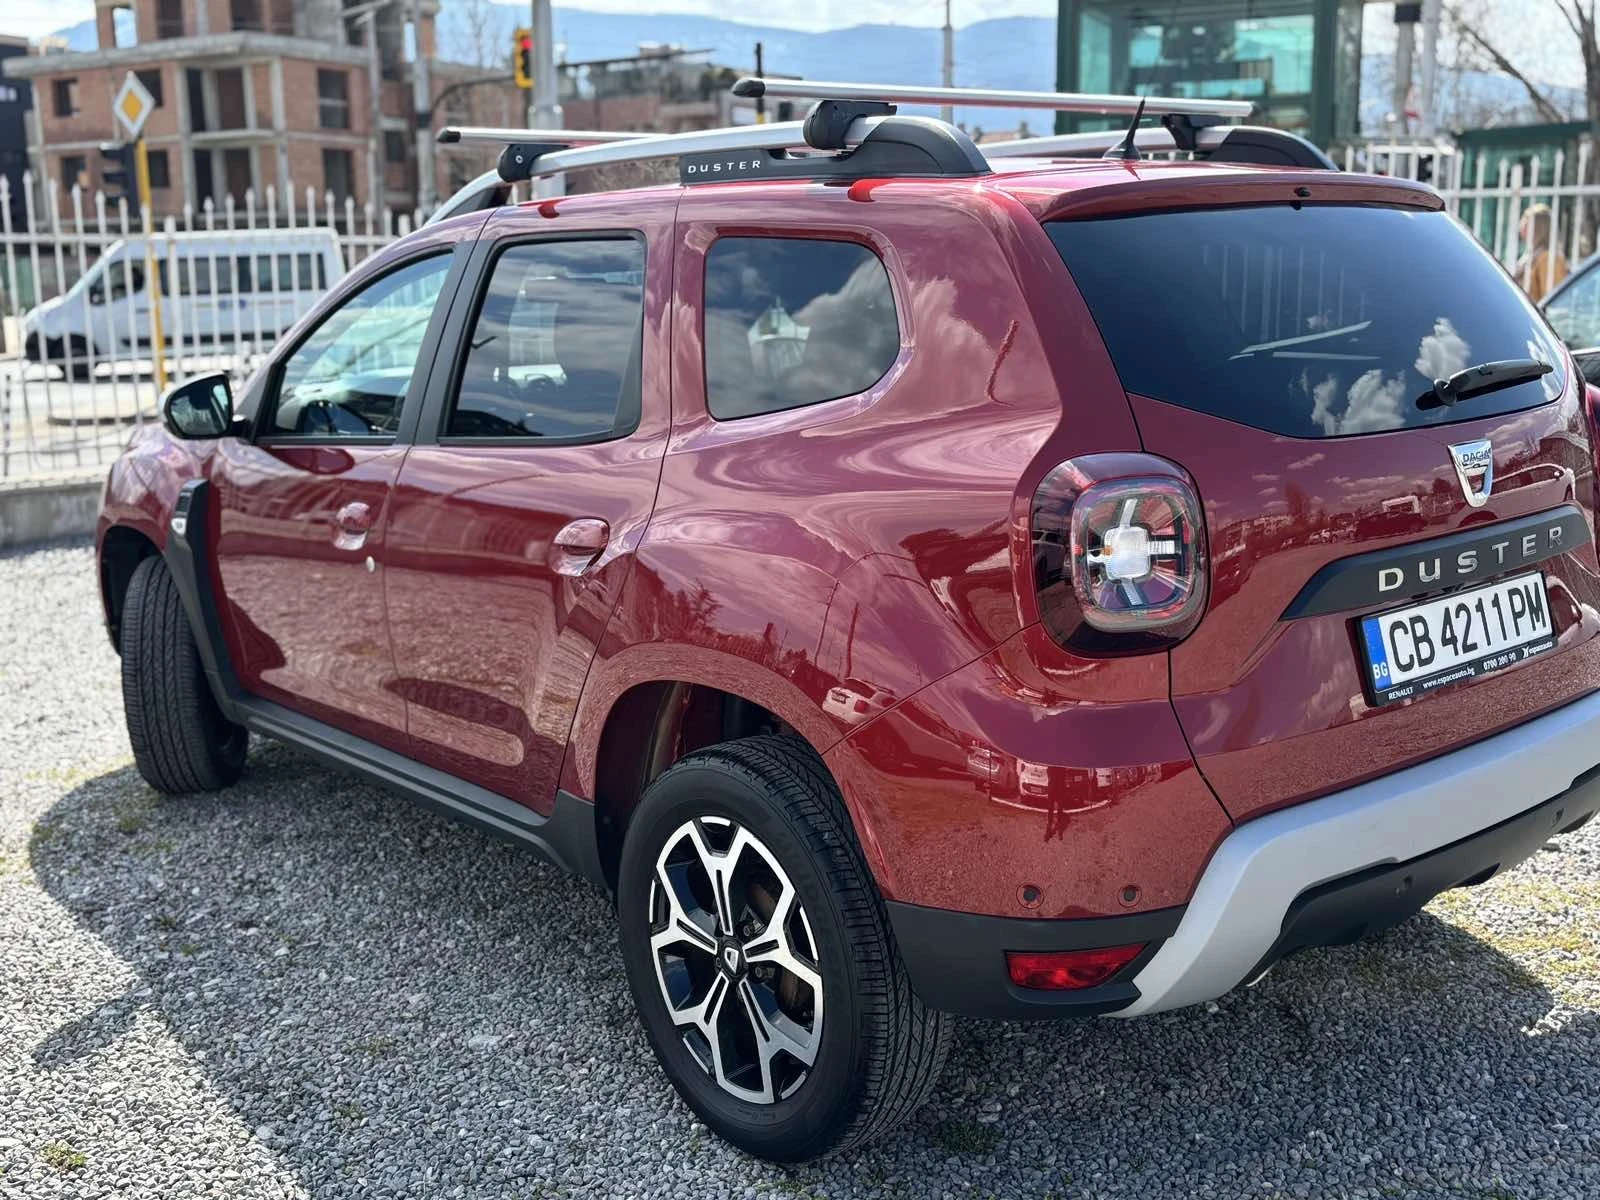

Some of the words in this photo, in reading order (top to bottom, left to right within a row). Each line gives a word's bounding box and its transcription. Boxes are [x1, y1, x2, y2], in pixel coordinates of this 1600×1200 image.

[687, 160, 761, 174] DUSTER
[1462, 448, 1492, 463] DACIA
[1378, 526, 1562, 592] DUSTER
[1389, 615, 1435, 673] CB
[1441, 592, 1508, 656] 4211
[1507, 582, 1547, 637] PM
[1373, 662, 1388, 679] BG
[1388, 687, 1413, 700] RENAULT
[1483, 659, 1497, 671] 0700
